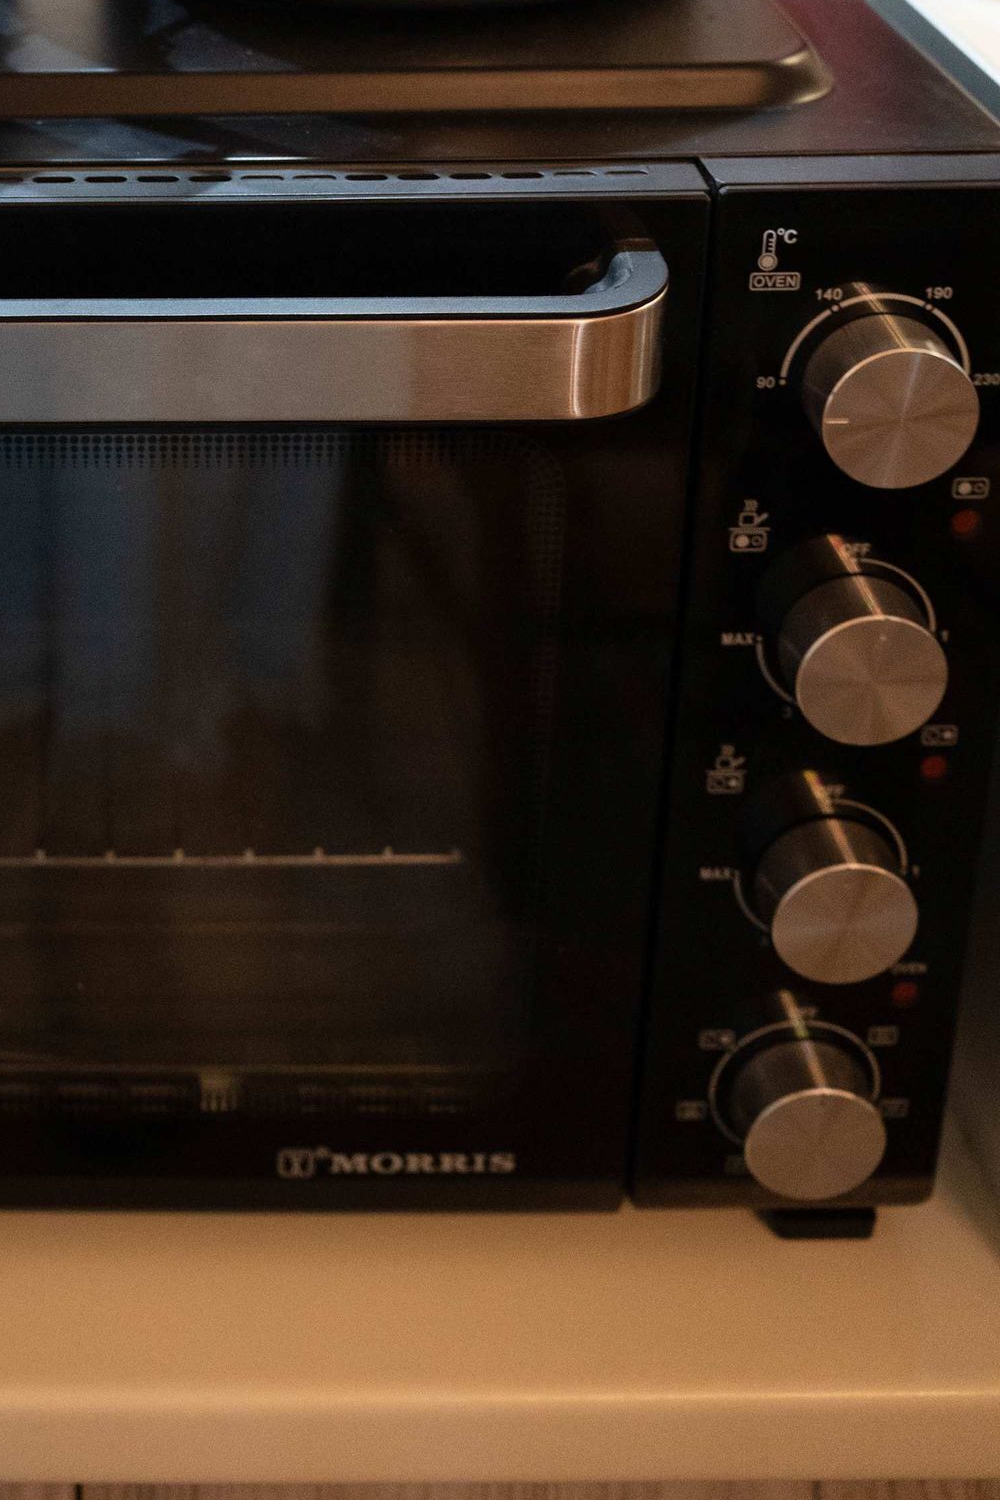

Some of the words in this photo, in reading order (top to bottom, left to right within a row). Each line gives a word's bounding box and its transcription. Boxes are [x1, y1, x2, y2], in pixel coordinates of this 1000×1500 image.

[753, 274, 797, 289] OVEN
[814, 287, 843, 301] 140
[924, 286, 954, 300] 190
[755, 376, 776, 389] 90
[720, 631, 754, 647] MAX
[327, 1152, 517, 1175] MORRIS
